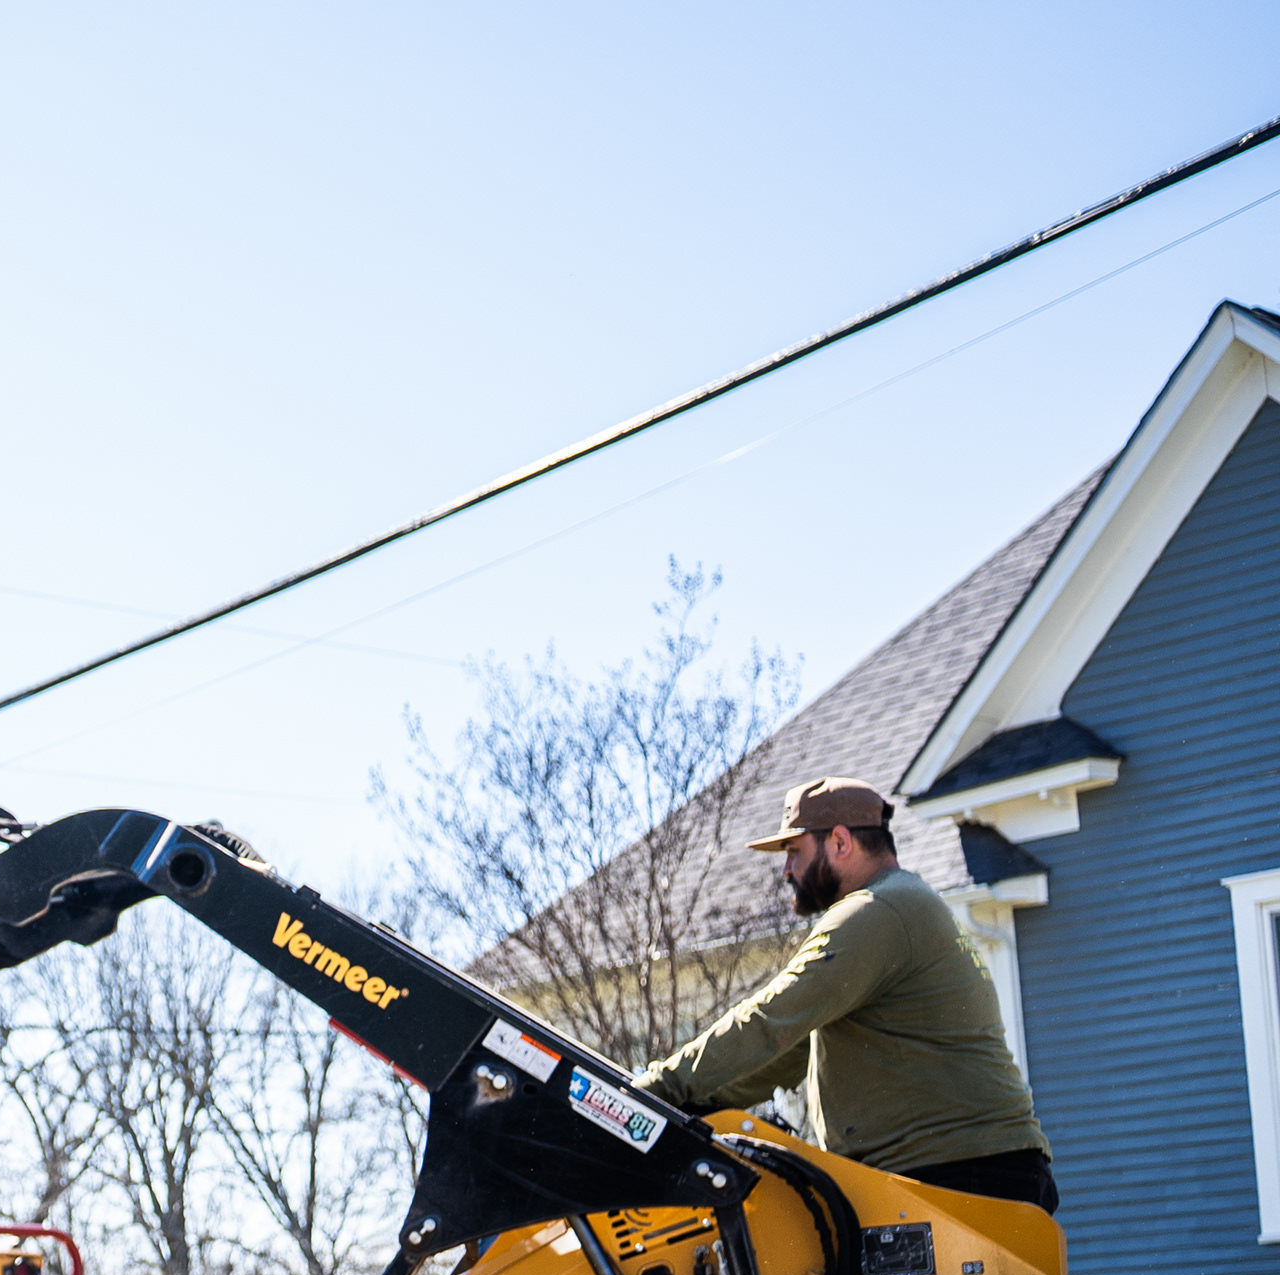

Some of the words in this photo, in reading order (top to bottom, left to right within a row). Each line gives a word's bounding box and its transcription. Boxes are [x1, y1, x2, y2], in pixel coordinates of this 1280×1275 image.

[272, 911, 401, 1010] Vermeer
[583, 1080, 635, 1124] Texas
[627, 1111, 657, 1137] 811
